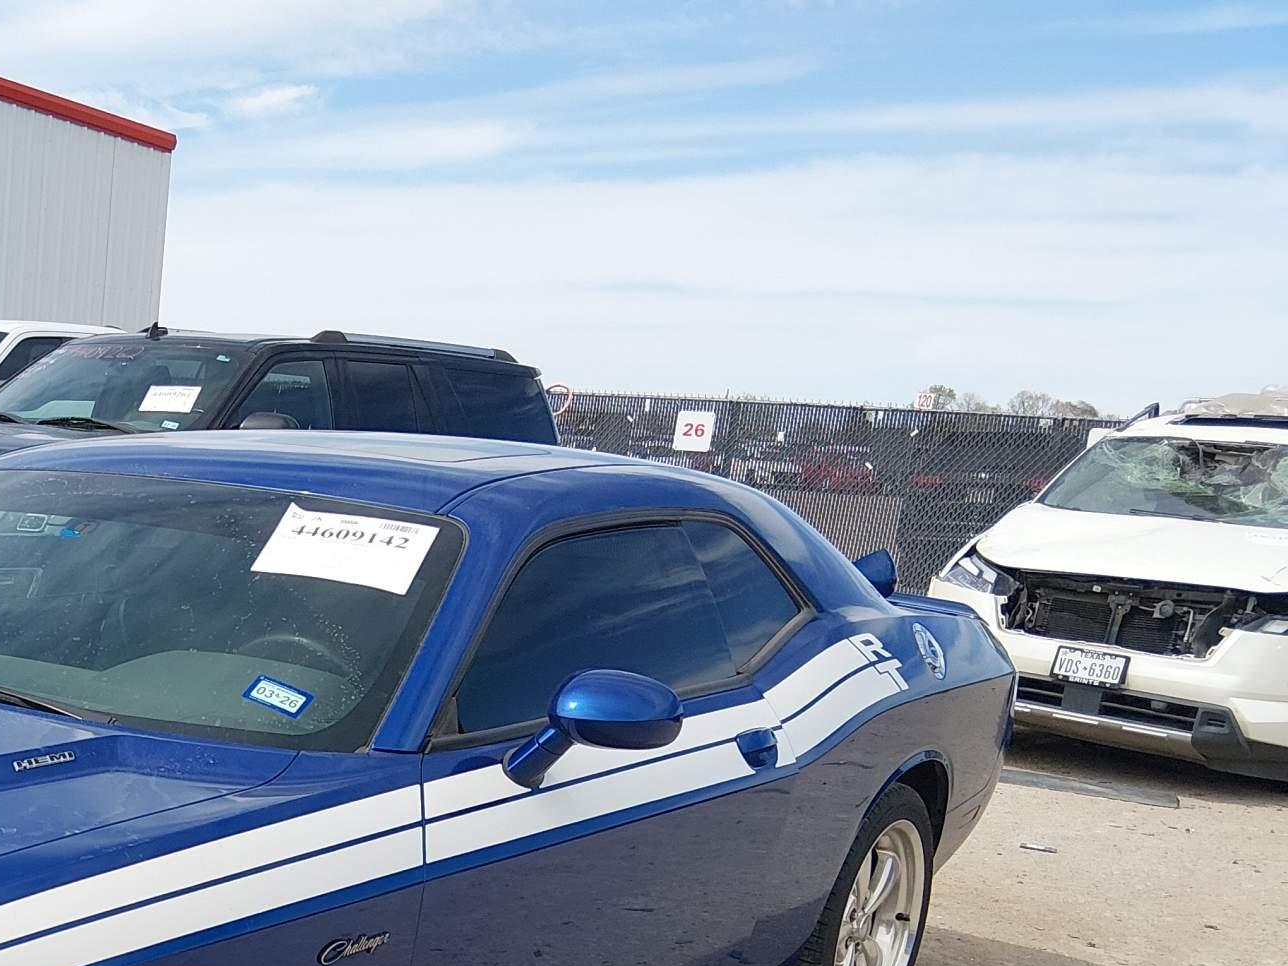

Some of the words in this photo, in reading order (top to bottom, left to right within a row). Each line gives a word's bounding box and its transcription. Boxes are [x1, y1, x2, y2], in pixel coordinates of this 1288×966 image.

[918, 394, 933, 409] 120
[682, 422, 706, 438] 26
[290, 524, 410, 550] 44609142
[1080, 651, 1106, 661] TEXAS
[13, 751, 75, 772] HEMI
